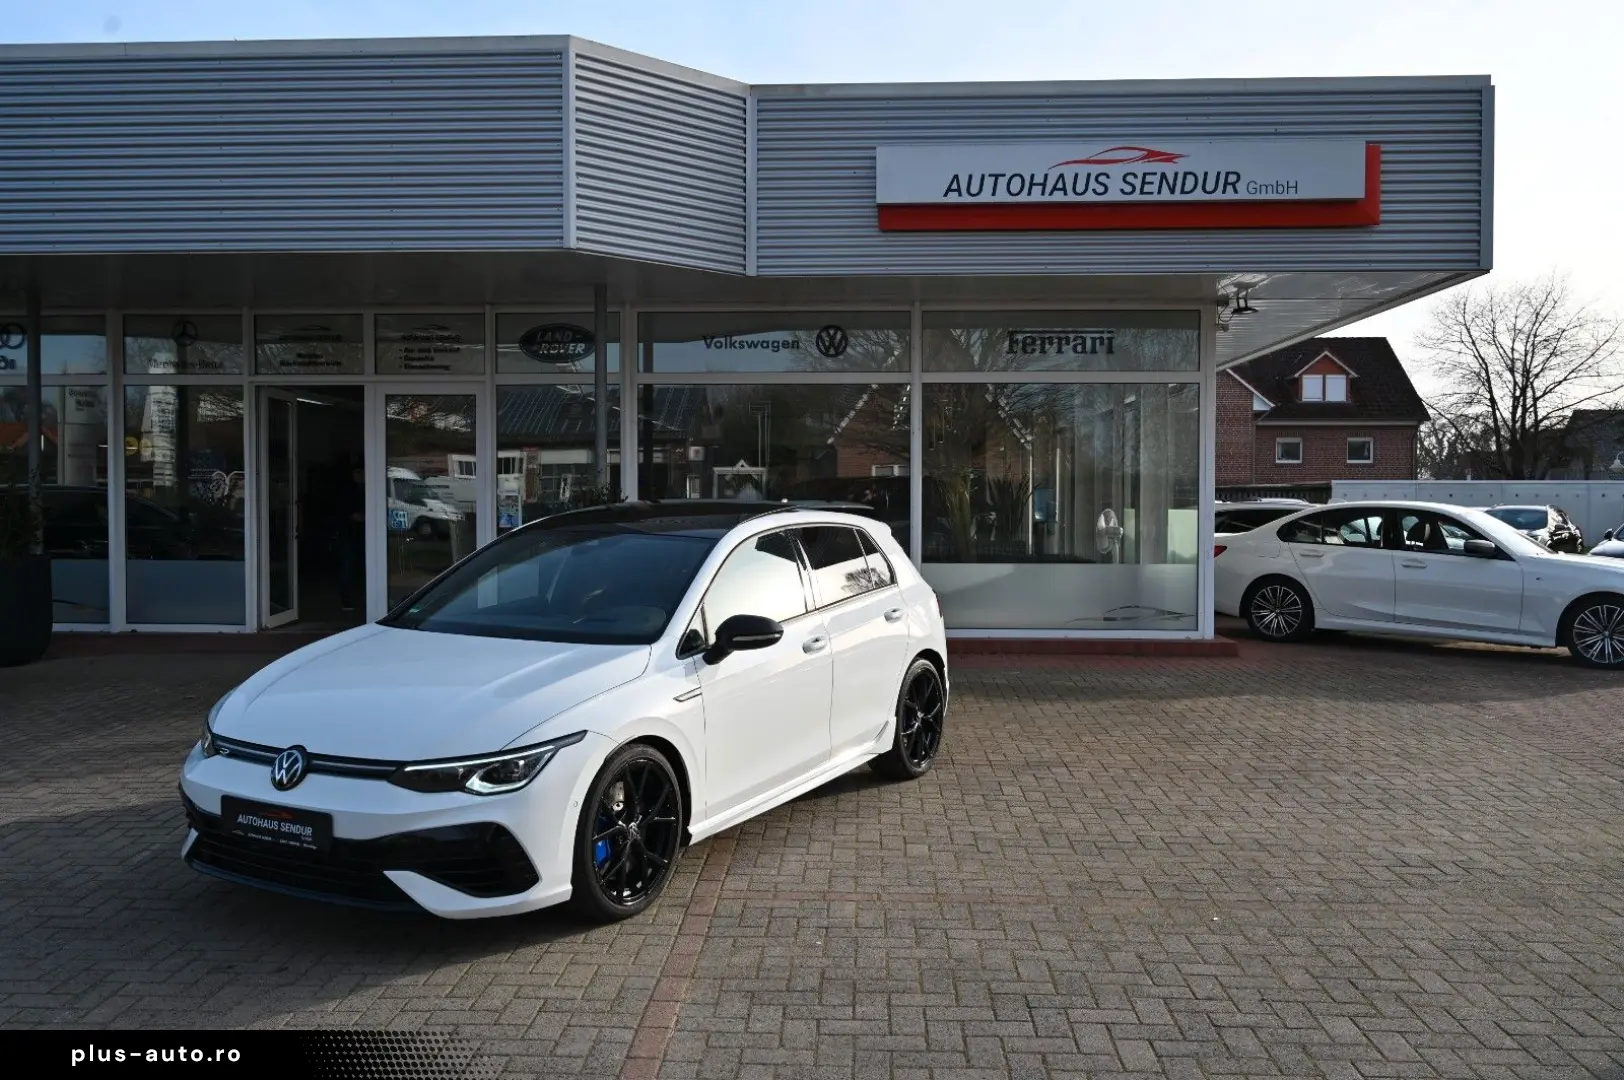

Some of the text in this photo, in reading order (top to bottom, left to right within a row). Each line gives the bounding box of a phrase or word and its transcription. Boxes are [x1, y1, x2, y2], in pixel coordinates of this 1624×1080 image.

[943, 169, 1299, 199] AUTOHAUS SENDUR GmbH
[536, 331, 574, 342] LAND
[702, 334, 800, 353] Volkswagen
[1006, 330, 1115, 354] Ferrari
[539, 343, 586, 354] ROVER
[237, 813, 313, 837] AUTOHAUS SENDUR
